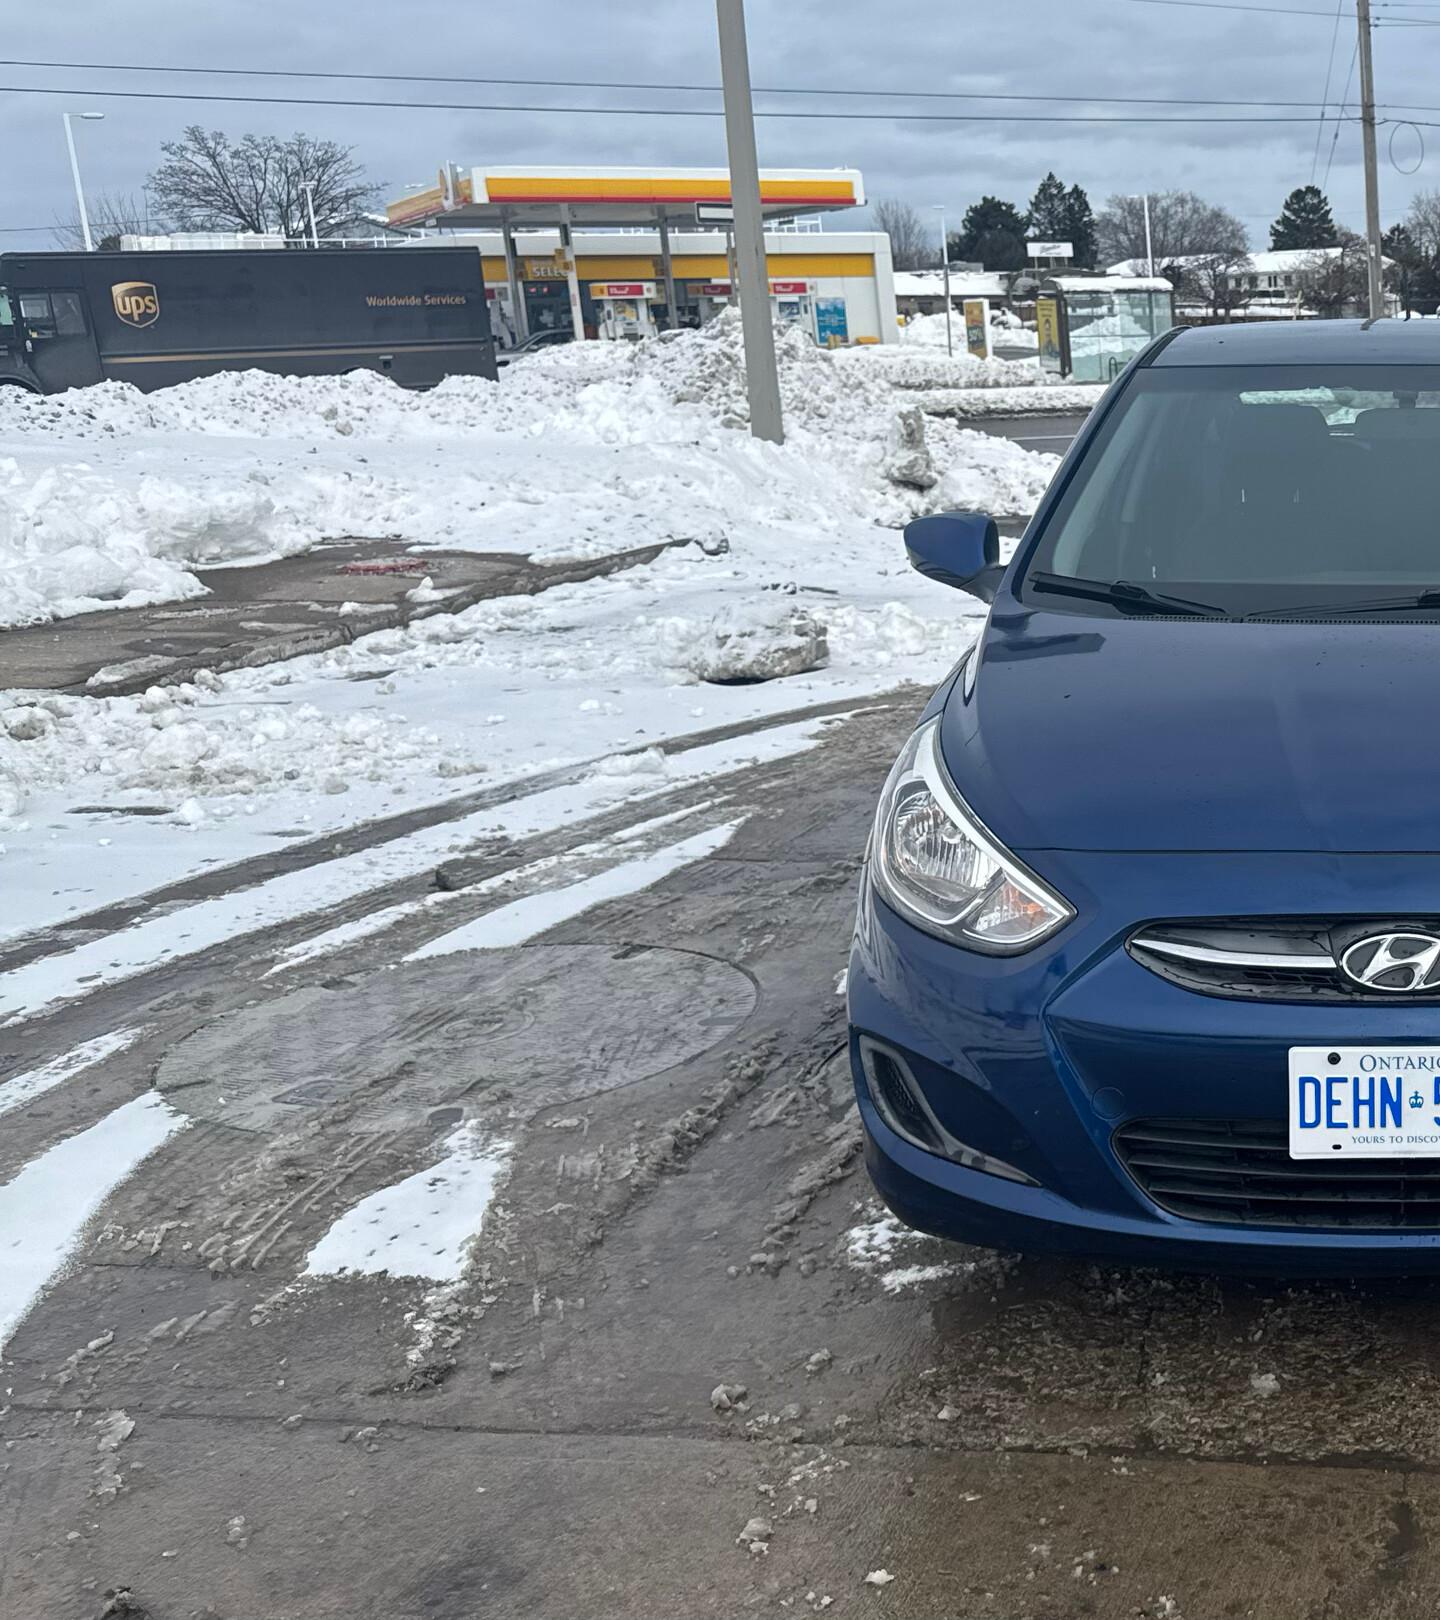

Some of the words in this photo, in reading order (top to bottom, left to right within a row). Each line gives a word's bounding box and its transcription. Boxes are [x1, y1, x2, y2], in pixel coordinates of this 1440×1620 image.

[116, 295, 157, 322] ups
[366, 296, 421, 306] Worldwide
[424, 295, 466, 305] Services
[1298, 1076, 1403, 1129] DEHN
[1352, 1135, 1385, 1144] YOURS
[1389, 1135, 1403, 1143] TO
